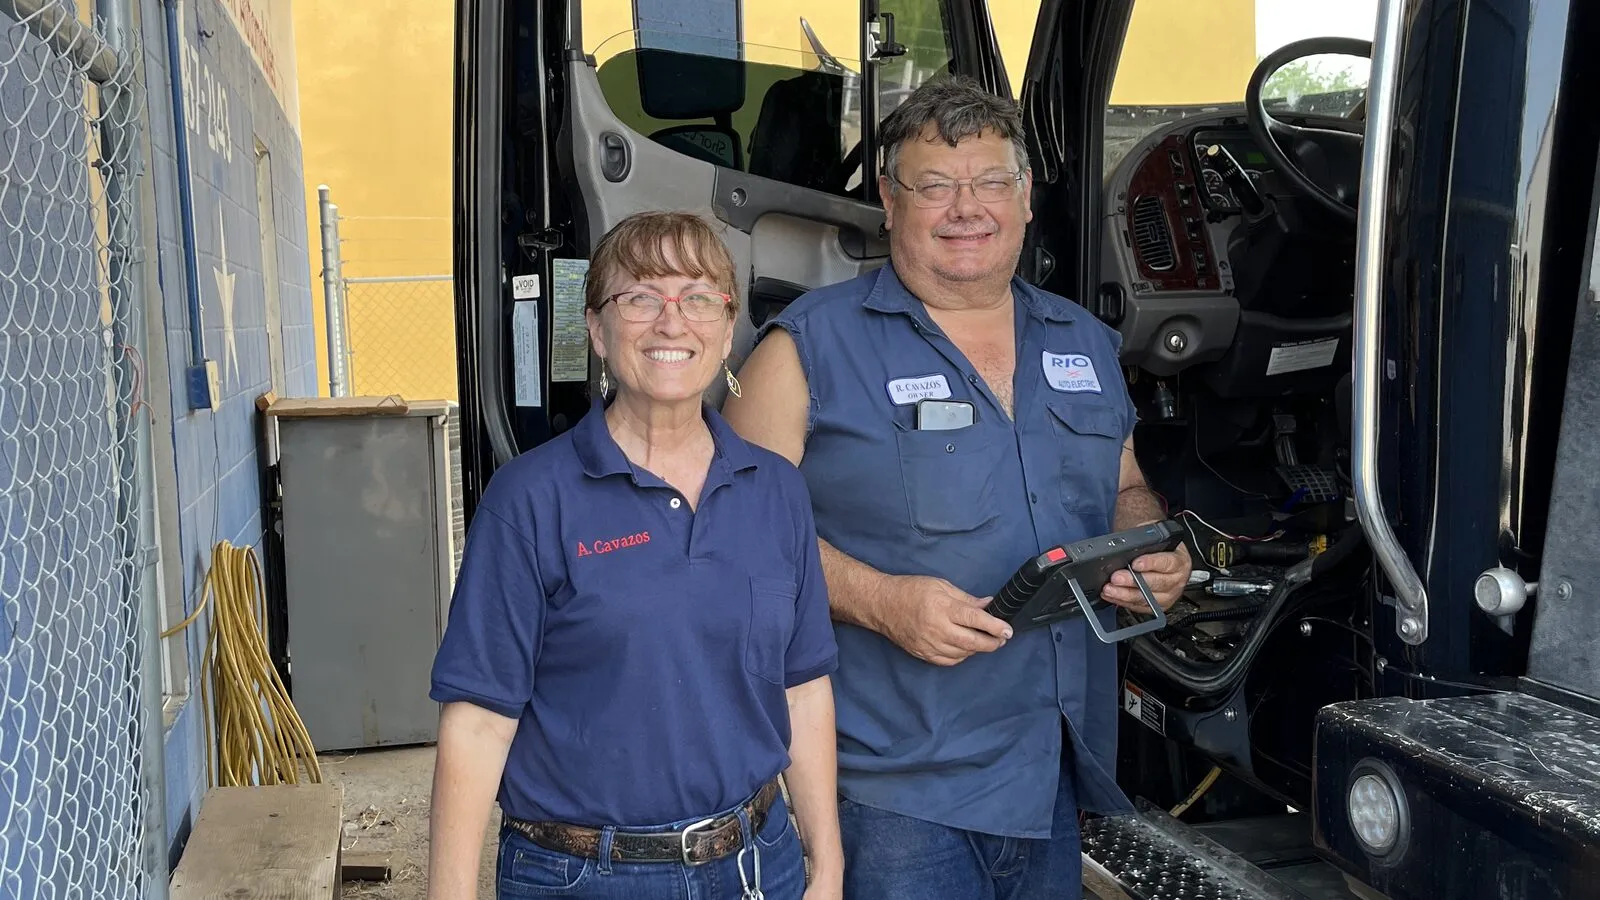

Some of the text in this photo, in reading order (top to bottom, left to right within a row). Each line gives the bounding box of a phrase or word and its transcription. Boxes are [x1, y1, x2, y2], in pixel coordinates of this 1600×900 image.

[518, 279, 534, 288] VOID
[1052, 357, 1089, 368] RIO
[896, 380, 941, 392] R. CAVAZOS
[1058, 379, 1097, 389] AUTO ELECTRIC
[907, 391, 934, 399] OWNER
[577, 531, 650, 557] A. Cavazos
